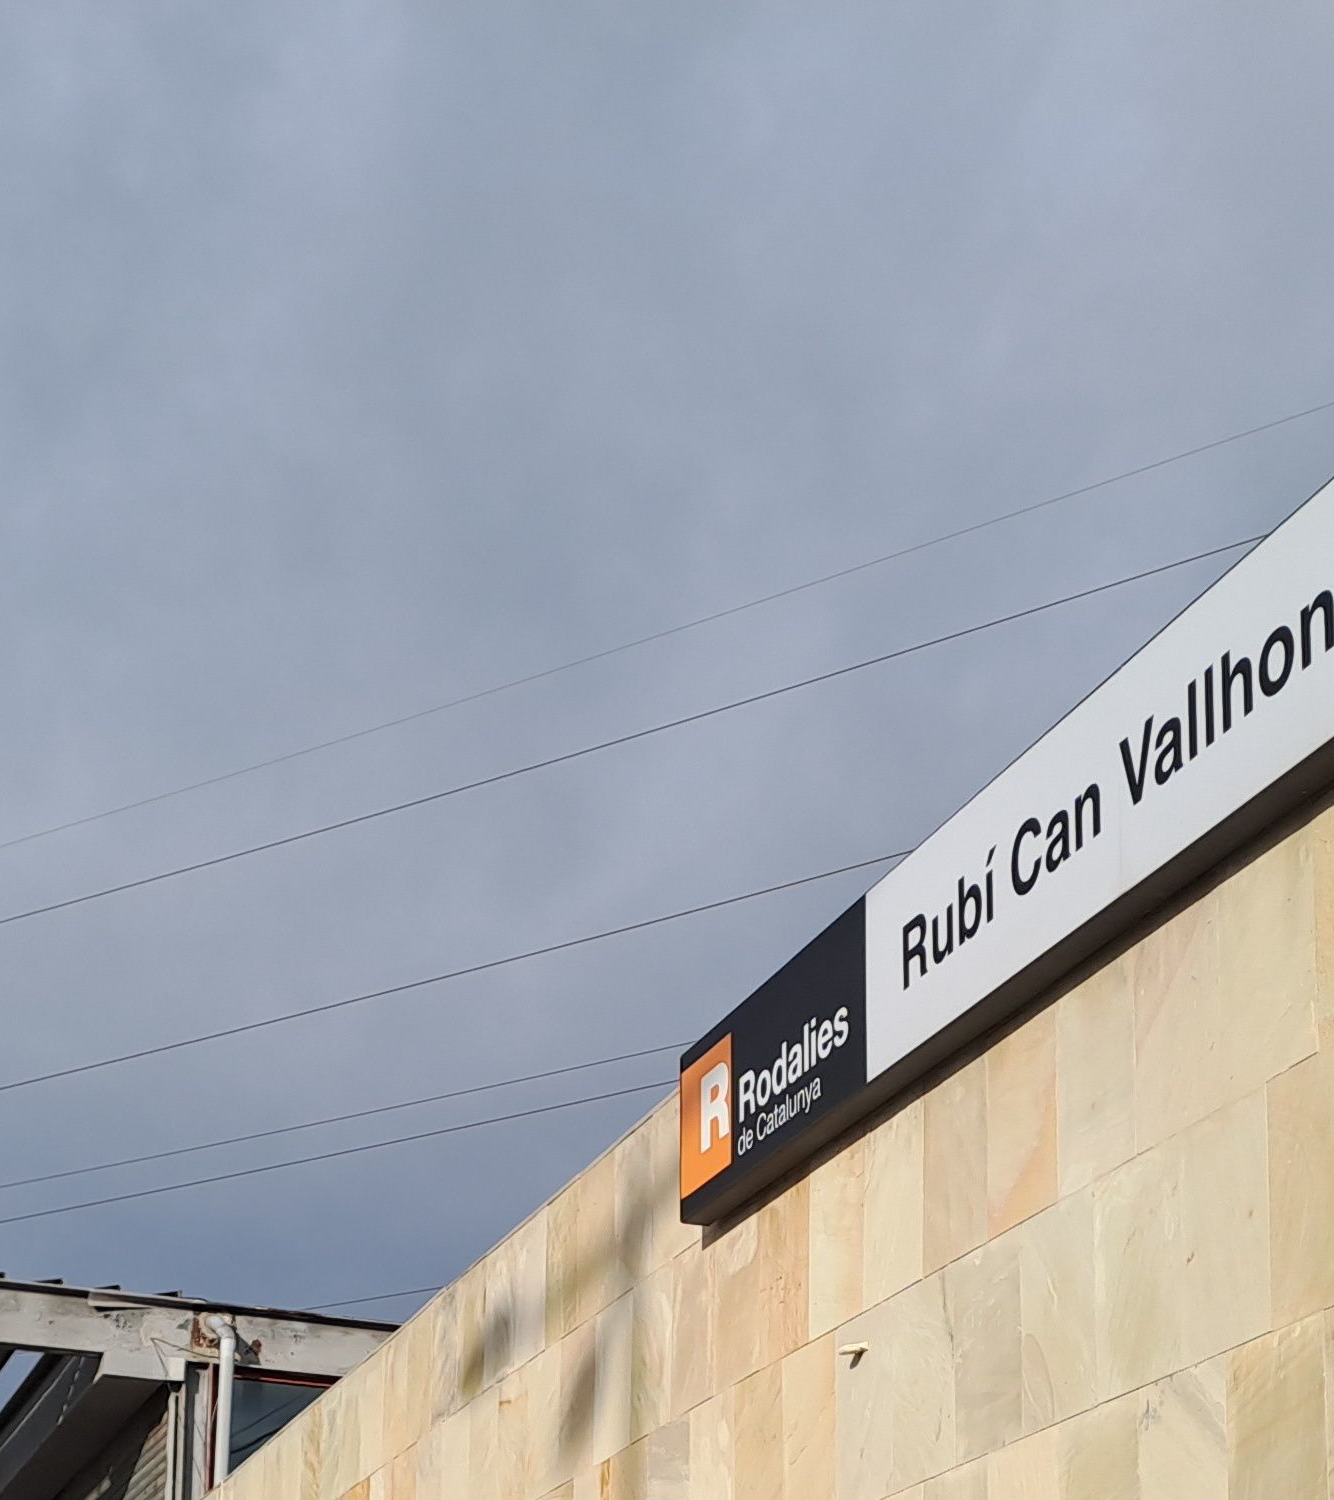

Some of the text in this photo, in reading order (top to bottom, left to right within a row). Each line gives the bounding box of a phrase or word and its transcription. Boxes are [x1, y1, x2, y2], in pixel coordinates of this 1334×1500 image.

[902, 845, 996, 990] Rubí
[1010, 783, 1101, 896] Can
[700, 1061, 730, 1154] R
[737, 1076, 821, 1156] de Catalunya
[738, 1006, 849, 1123] Rodalies
